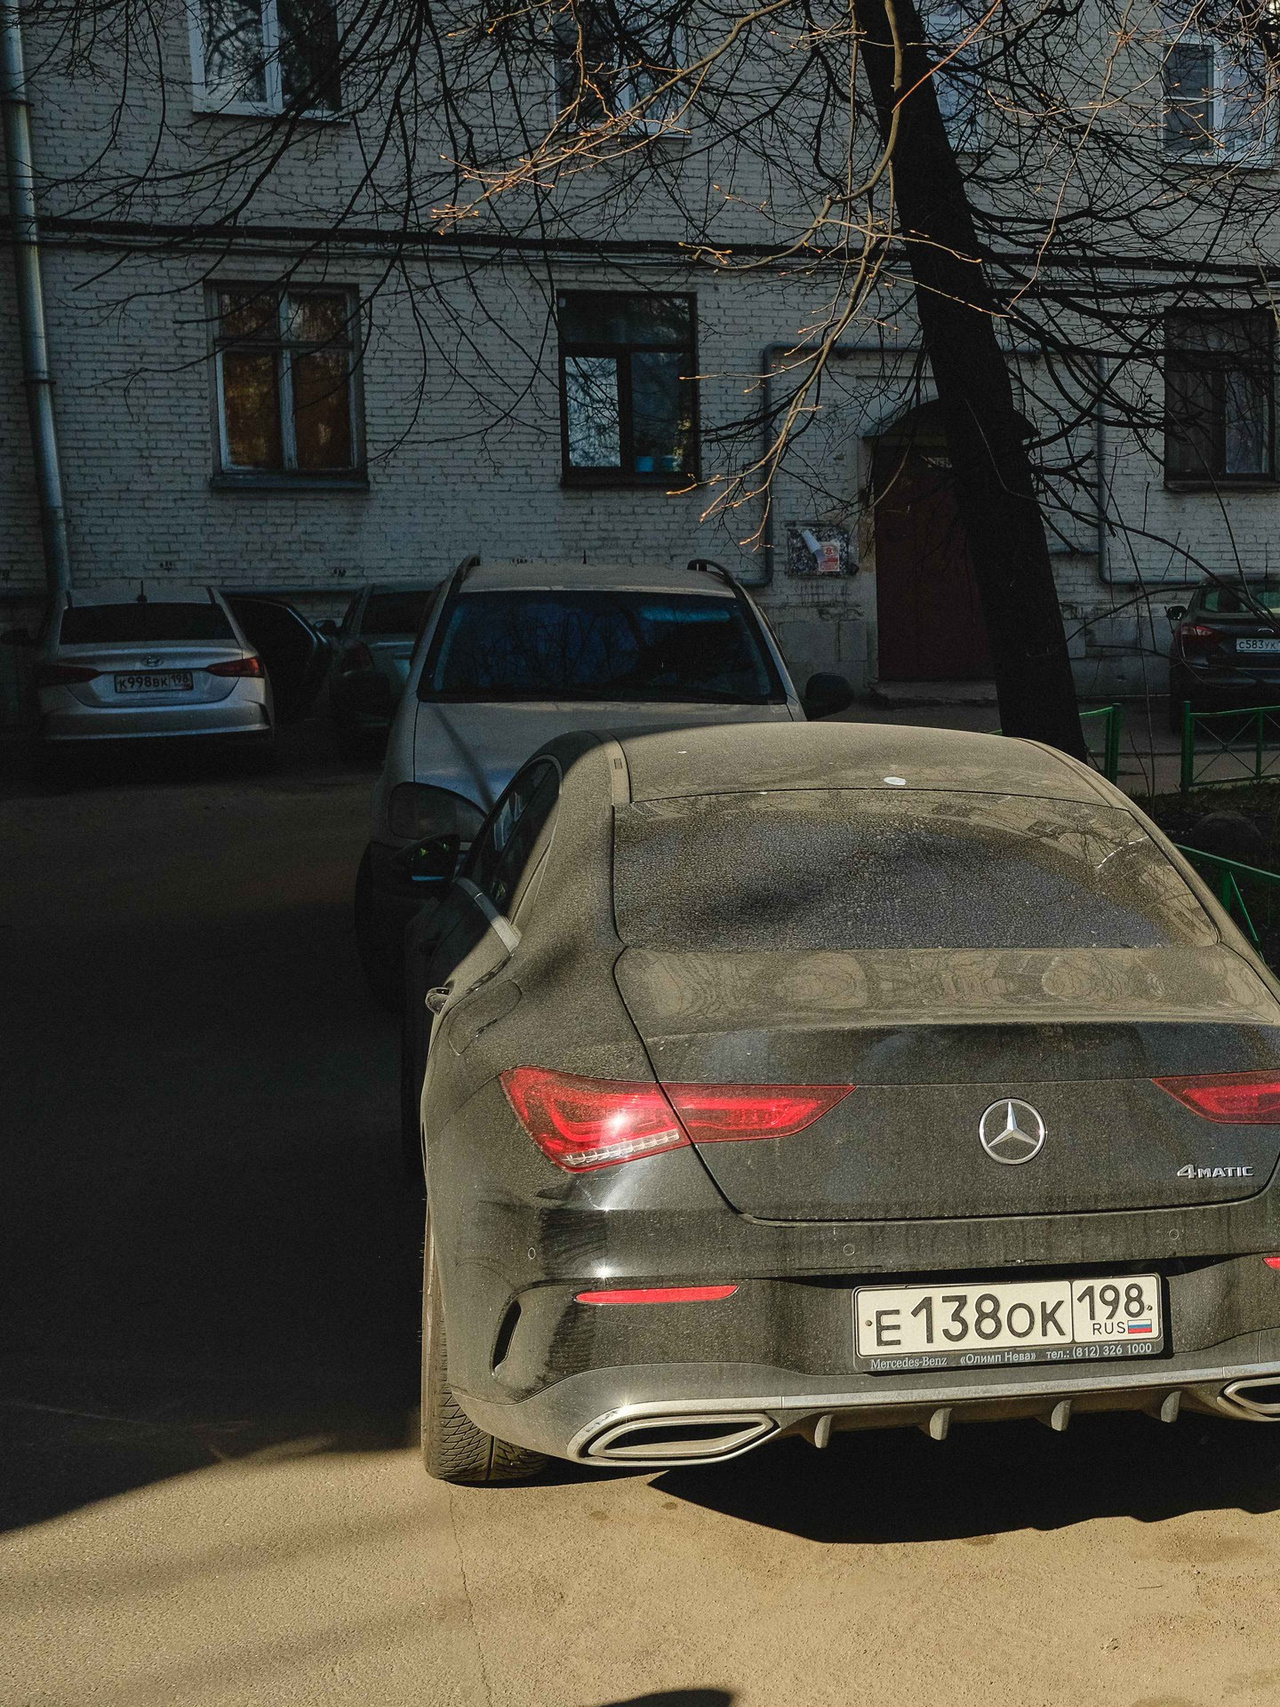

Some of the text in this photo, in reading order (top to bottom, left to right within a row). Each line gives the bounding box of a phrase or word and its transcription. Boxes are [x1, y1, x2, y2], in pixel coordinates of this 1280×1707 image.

[1176, 1163, 1255, 1179] 4MATIC
[875, 1283, 1145, 1347] Е138ОК 198
[1092, 1322, 1126, 1336] RUS
[870, 1356, 948, 1370] Mercedes-Benz
[1046, 1349, 1070, 1359] тел.:
[1072, 1345, 1100, 1359] (812)
[1102, 1344, 1123, 1356] 326
[1126, 1342, 1152, 1354] 1000
